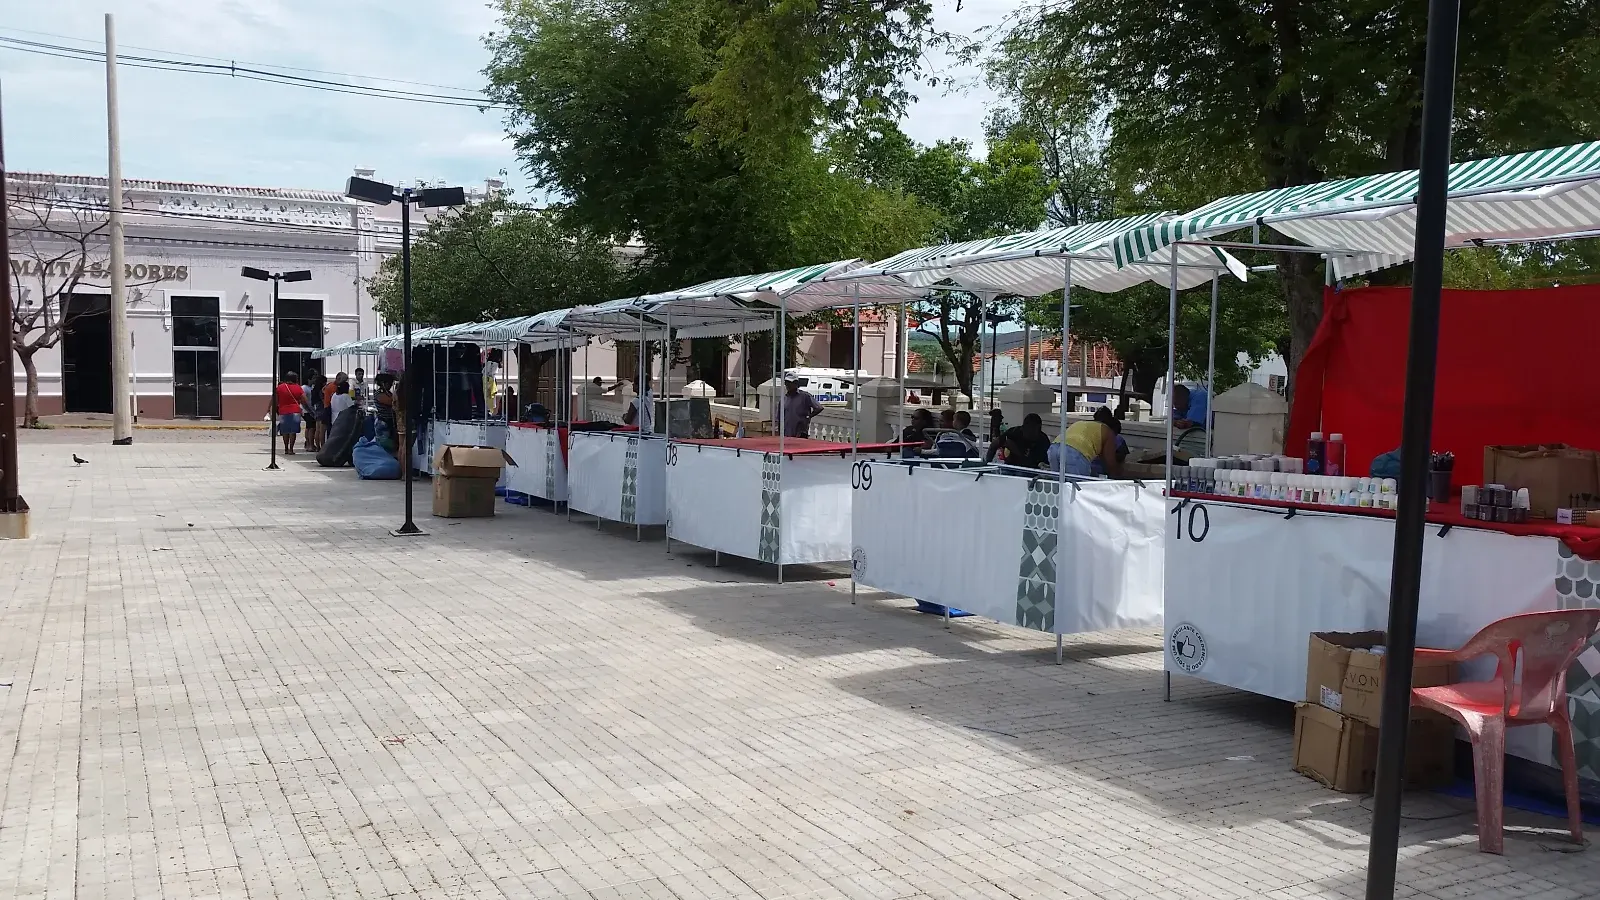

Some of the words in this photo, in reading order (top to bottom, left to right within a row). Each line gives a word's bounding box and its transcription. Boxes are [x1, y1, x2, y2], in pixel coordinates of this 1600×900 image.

[90, 262, 188, 281] SBORES
[666, 444, 677, 466] 08
[852, 463, 872, 490] 09
[1171, 501, 1209, 542] 10
[1171, 625, 1195, 644] AMBULANTE
[1191, 632, 1206, 670] CREDENCIADO
